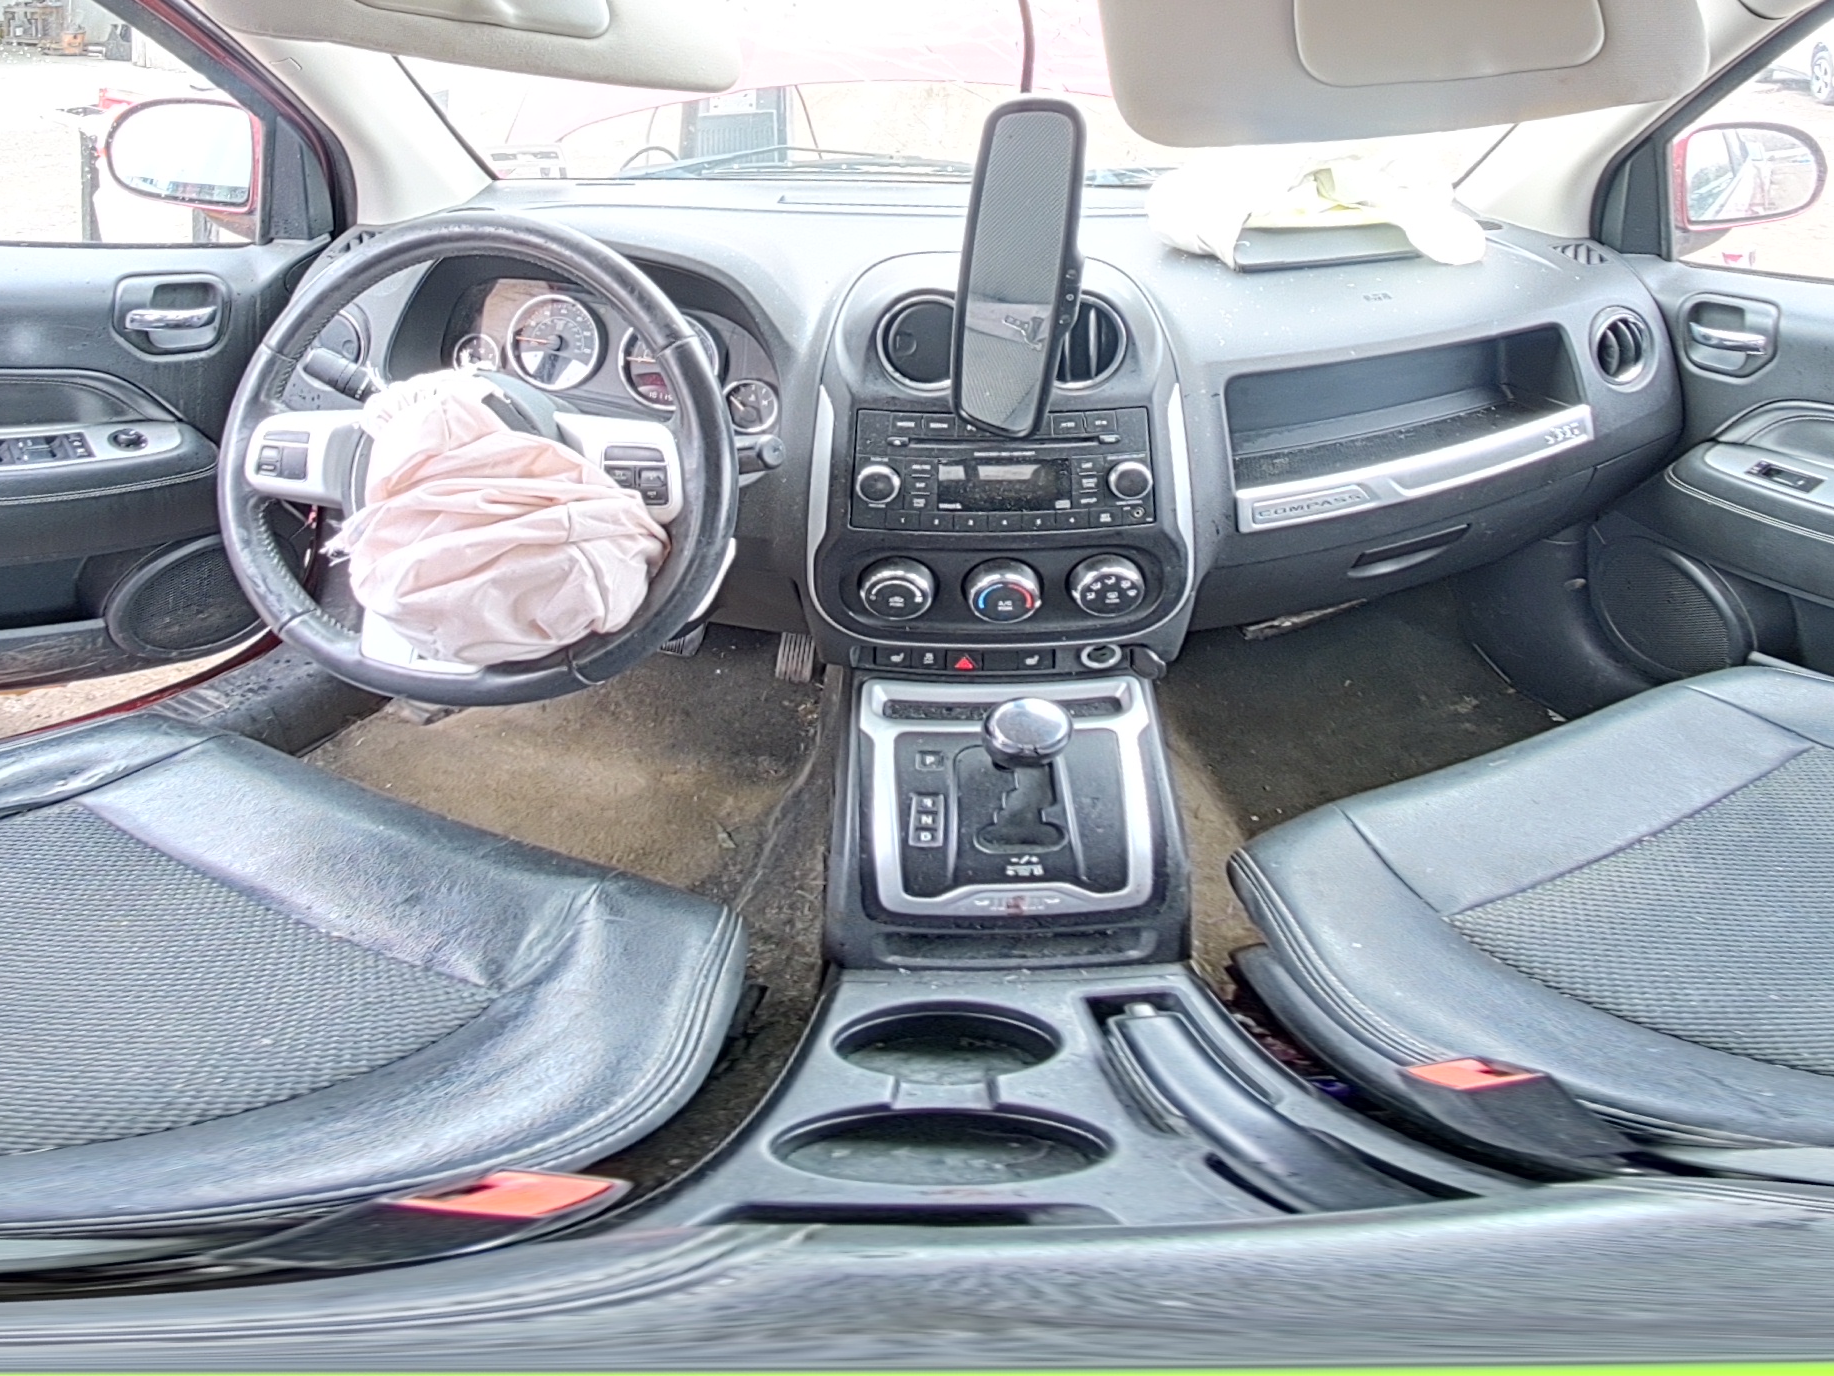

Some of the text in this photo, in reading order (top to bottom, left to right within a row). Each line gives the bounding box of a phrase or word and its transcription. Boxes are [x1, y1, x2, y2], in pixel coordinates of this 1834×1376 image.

[1257, 494, 1362, 518] COMPASS
[926, 756, 935, 764] P
[921, 815, 933, 824] N
[920, 831, 932, 842] D
